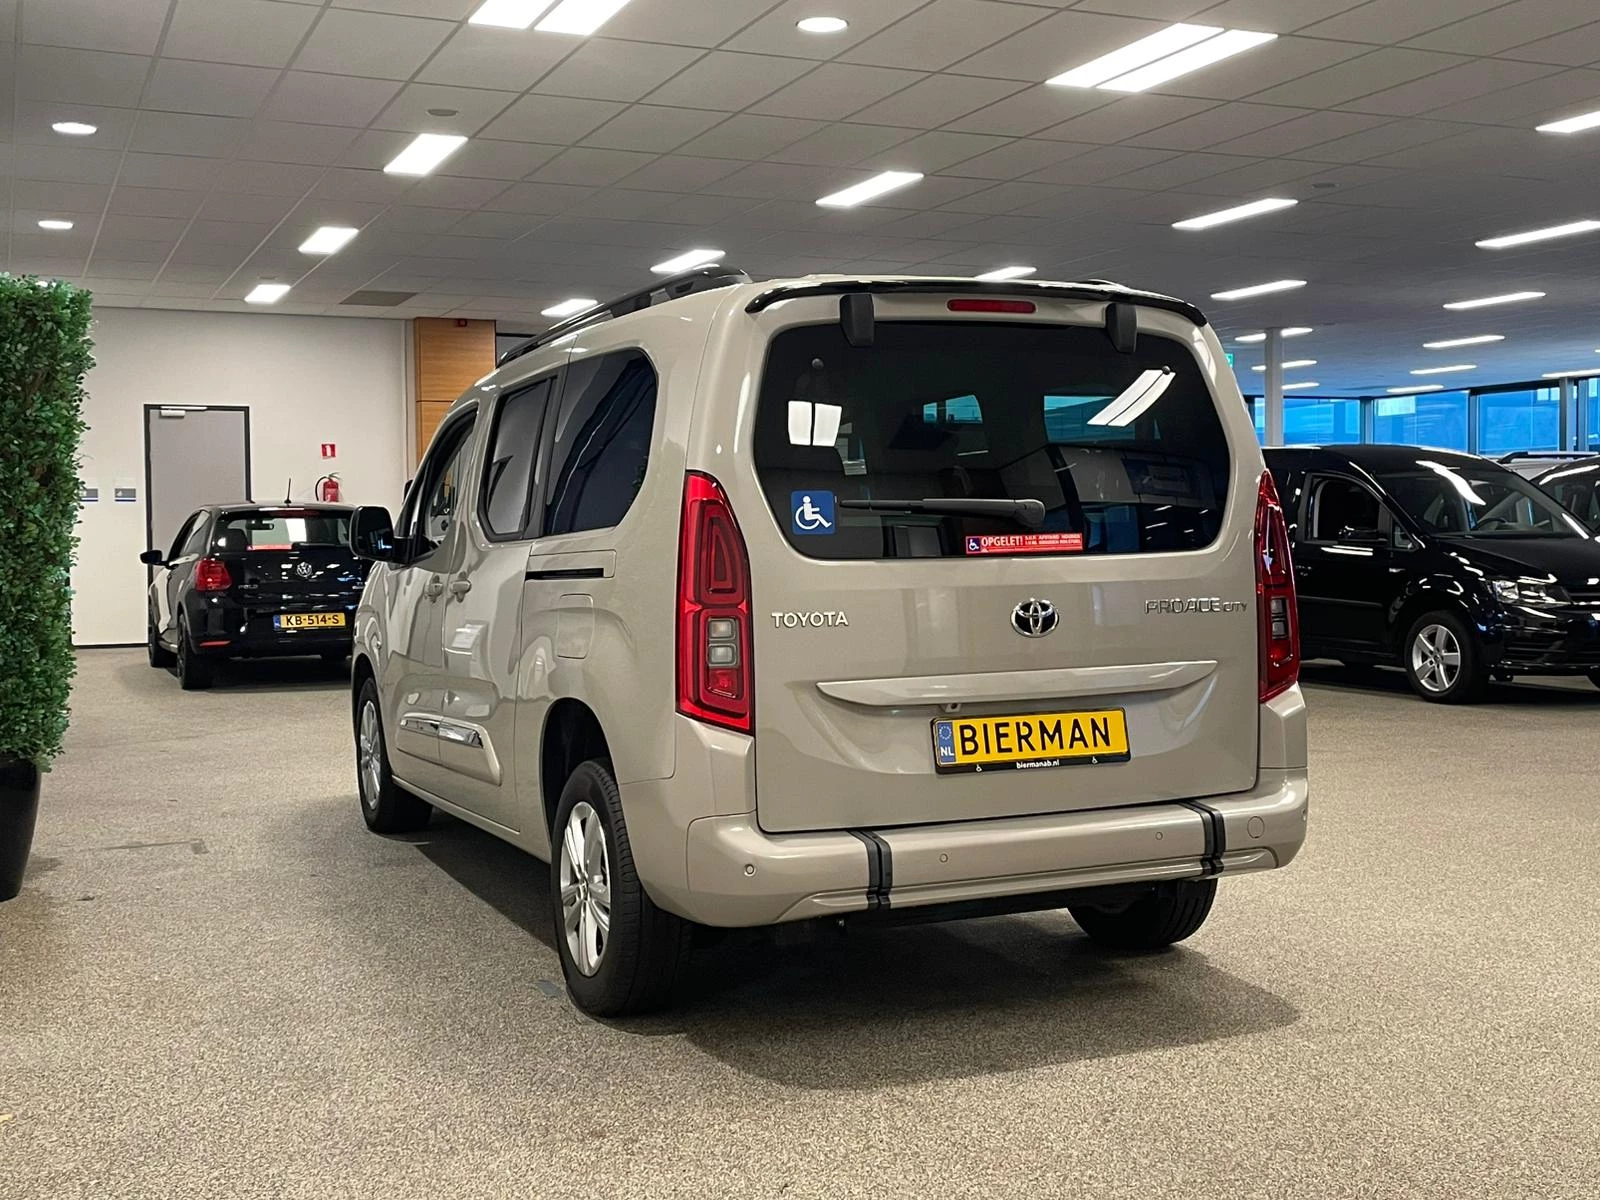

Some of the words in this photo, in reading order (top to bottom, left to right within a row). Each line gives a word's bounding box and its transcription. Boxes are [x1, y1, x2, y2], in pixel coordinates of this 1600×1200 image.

[981, 536, 1024, 547] OPGELET!
[1145, 597, 1220, 614] PROACE
[285, 614, 340, 626] KB-514-S
[771, 611, 849, 628] TOYOTA
[940, 746, 955, 757] NL
[959, 717, 1111, 756] BIERMAN
[1016, 759, 1060, 769] biermanab.nl
